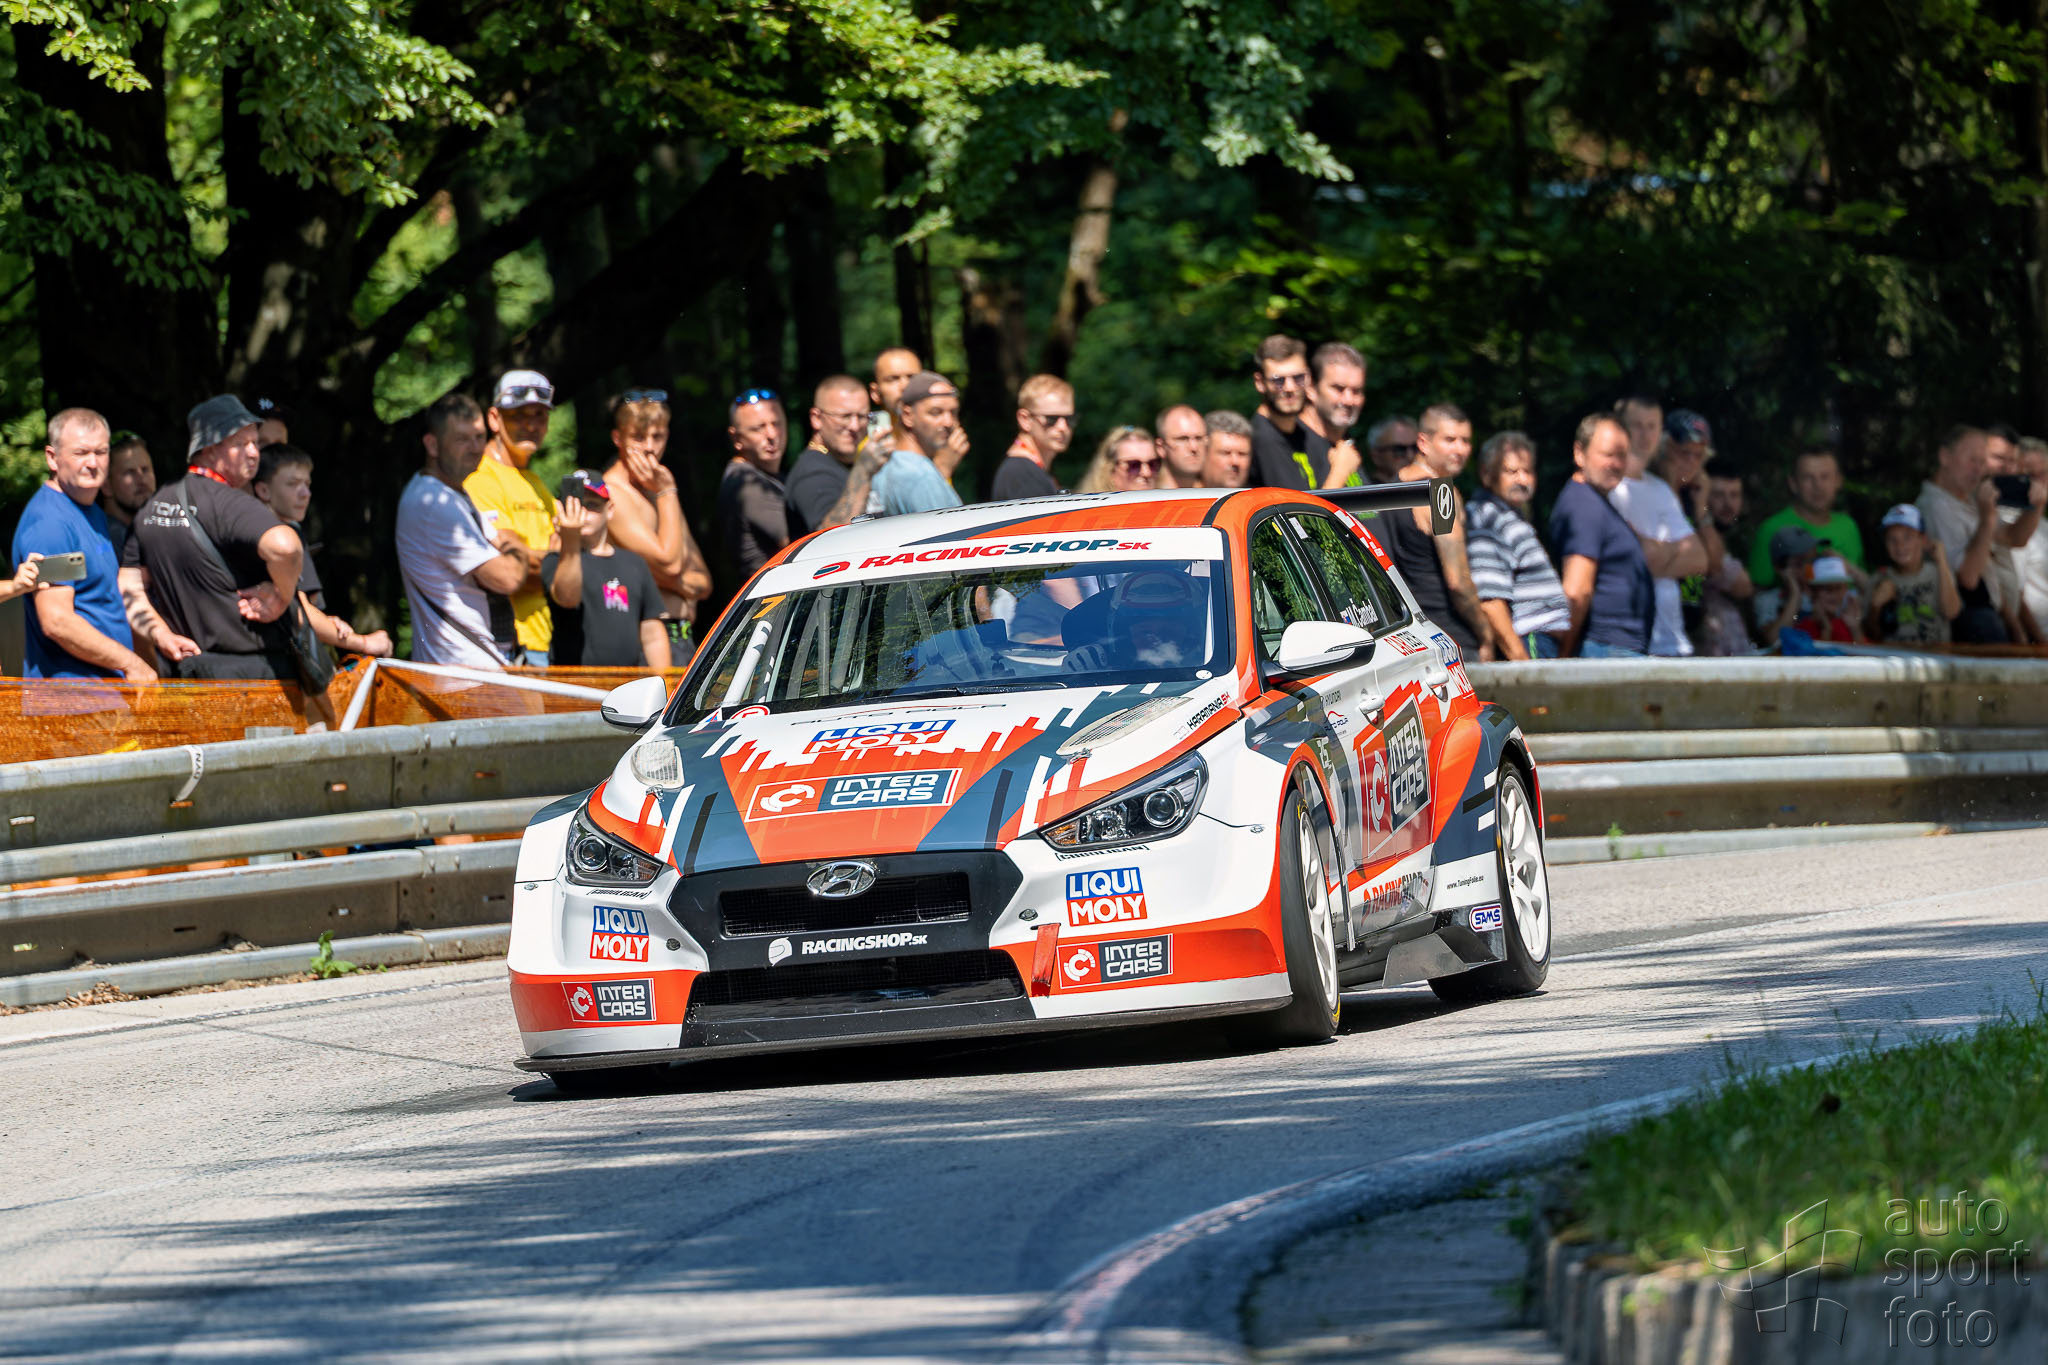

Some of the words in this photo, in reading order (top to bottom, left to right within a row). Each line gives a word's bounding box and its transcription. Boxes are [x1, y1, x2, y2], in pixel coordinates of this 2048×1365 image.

[817, 720, 949, 741] LIQUI
[810, 732, 944, 752] MOLY
[1388, 717, 1421, 775] INTER
[834, 773, 939, 792] INTER
[1392, 757, 1424, 815] CARS
[830, 787, 935, 806] CARS
[1069, 869, 1140, 897] LIQUI
[1070, 895, 1144, 925] MOLY
[1474, 909, 1501, 926] SAMS
[594, 908, 647, 934] LIQUI
[592, 934, 649, 960] MOLY
[1104, 941, 1163, 961] INTER
[1106, 956, 1163, 977] CARS
[597, 985, 645, 1001] INTER
[600, 1000, 647, 1017] CARS
